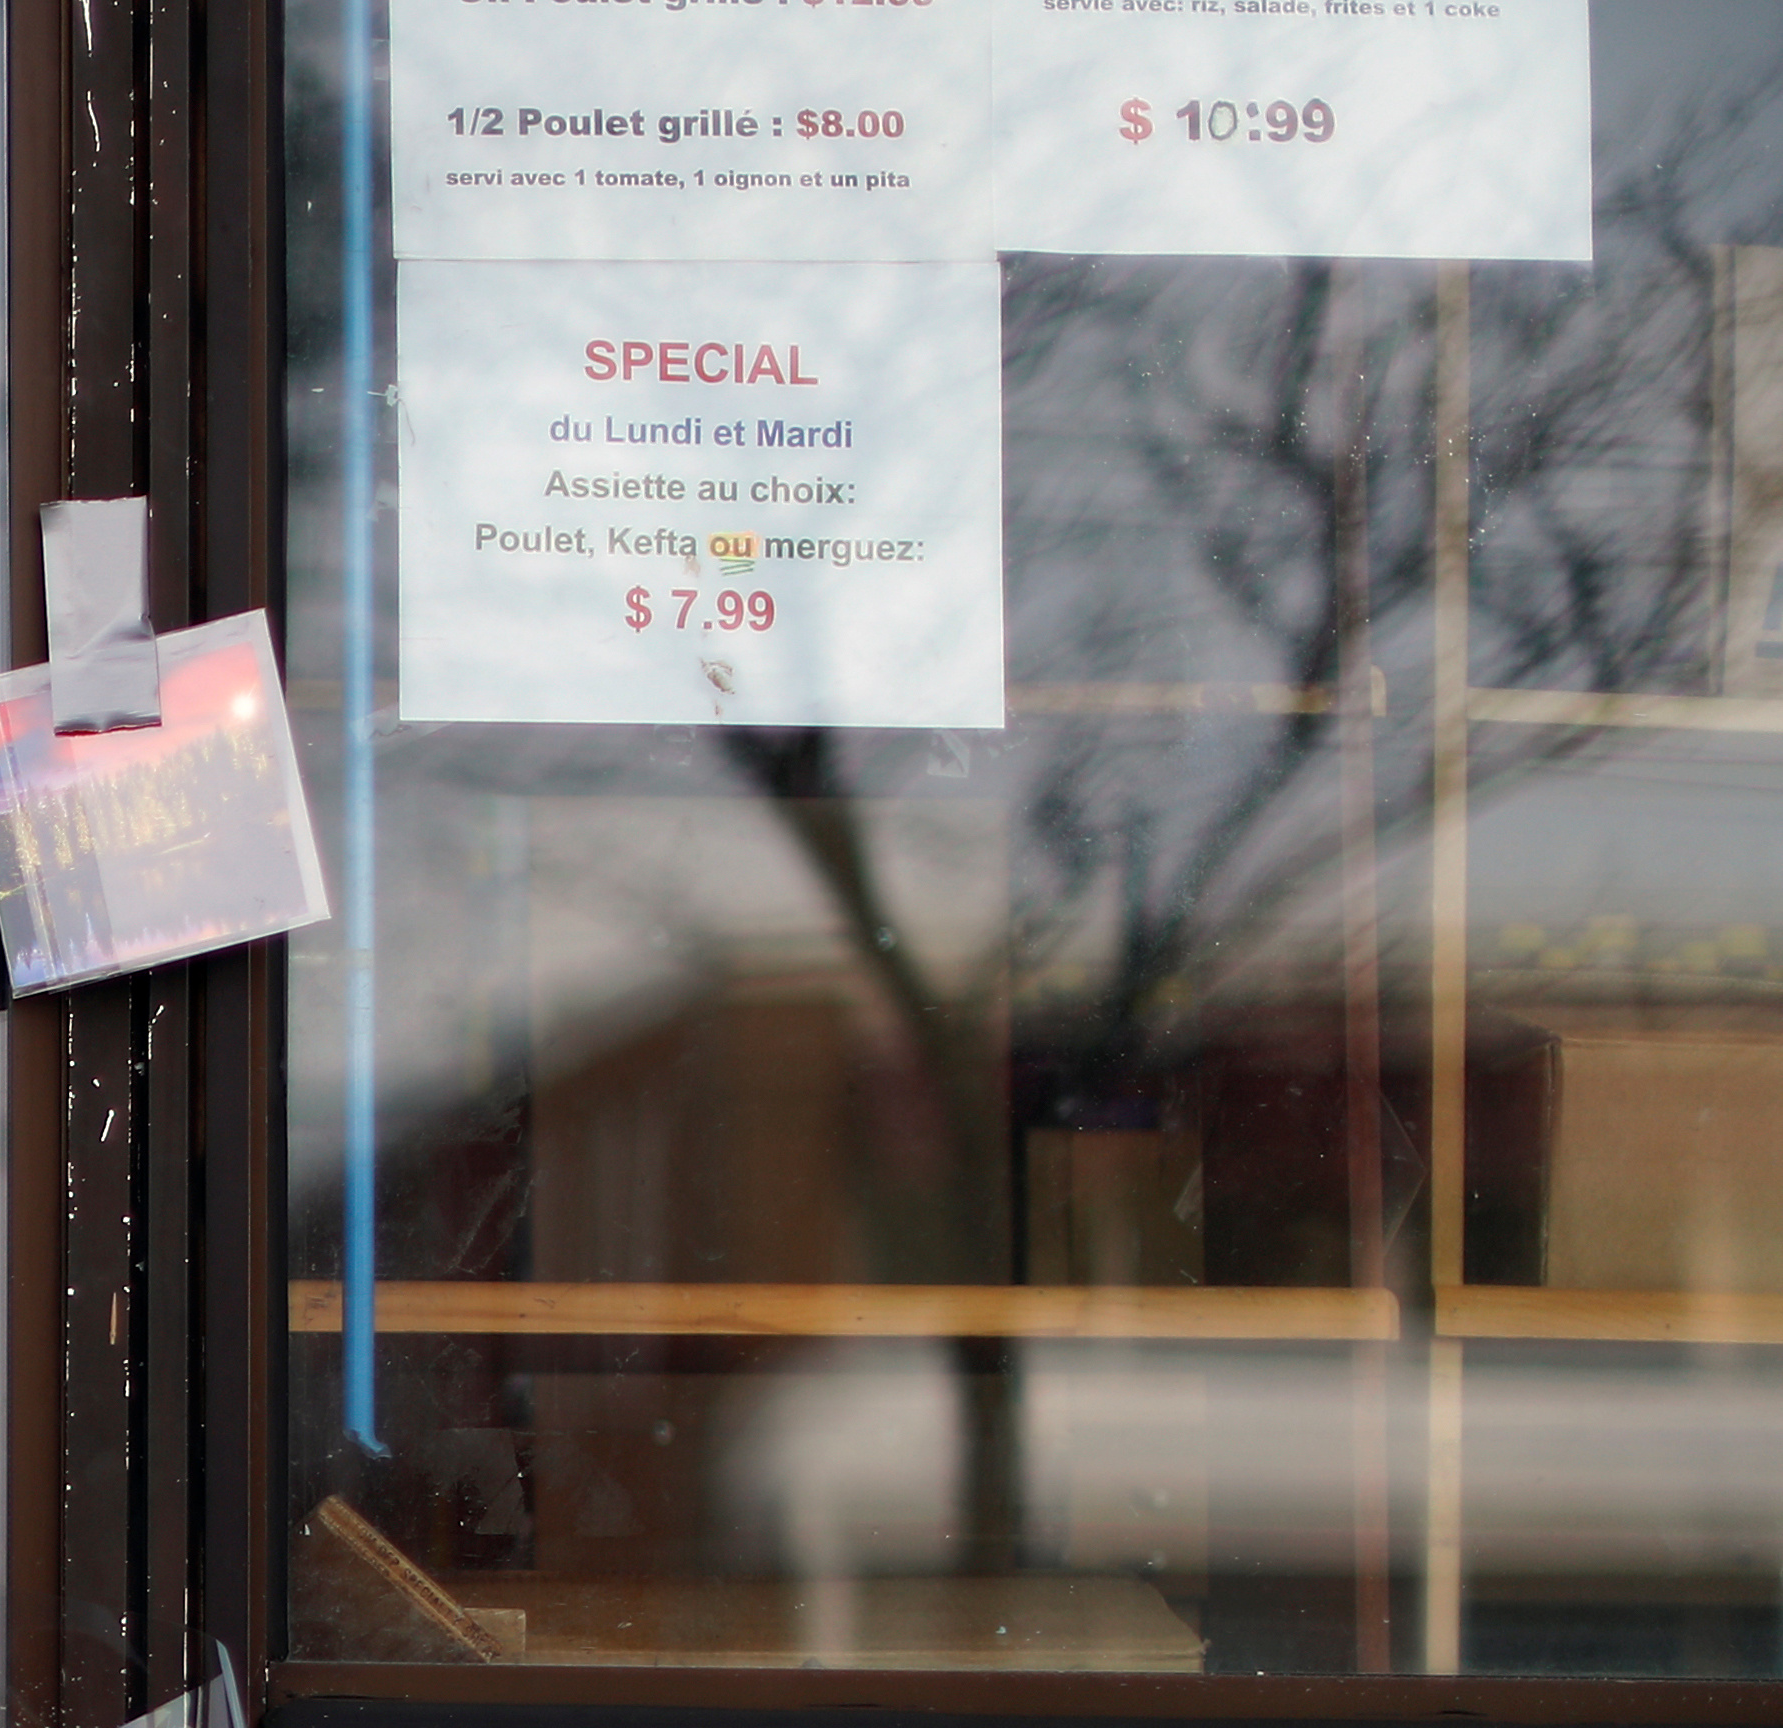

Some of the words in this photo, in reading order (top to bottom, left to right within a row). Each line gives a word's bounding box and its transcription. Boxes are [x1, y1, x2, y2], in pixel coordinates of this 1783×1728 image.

[1043, 0, 1114, 11] servie
[1122, 0, 1183, 12] avec:
[1192, 0, 1226, 16] riz,
[1234, 0, 1315, 16] salade,
[1325, 0, 1384, 15] frites
[1394, 1, 1415, 15] et
[1424, 0, 1435, 16] 1
[1444, 0, 1501, 18] coke
[447, 106, 504, 137] 1/2
[518, 107, 646, 137] Poulet
[658, 106, 758, 145] grillé
[797, 107, 905, 141] $8.00
[1119, 97, 1153, 145] $
[446, 168, 502, 186] servi
[510, 172, 566, 186] avec
[575, 168, 585, 186] 1
[594, 169, 686, 190] tomate,
[694, 169, 705, 187] 1
[713, 169, 791, 192] oignon
[800, 171, 823, 187] et
[830, 173, 859, 187] un
[866, 170, 910, 192] pita
[585, 339, 819, 386] SPECIAL
[550, 415, 591, 442] du
[606, 416, 702, 445] Lundi
[714, 419, 746, 447] et
[757, 419, 853, 449] Mardi
[544, 469, 686, 501] Assiette
[697, 479, 739, 503] au
[749, 476, 856, 504] choix:
[475, 523, 595, 558] Poulet,
[608, 527, 698, 556] Kefta
[709, 535, 753, 558] ou
[764, 537, 924, 567] merguez:
[625, 585, 652, 633] $
[671, 589, 775, 632] 7.99
